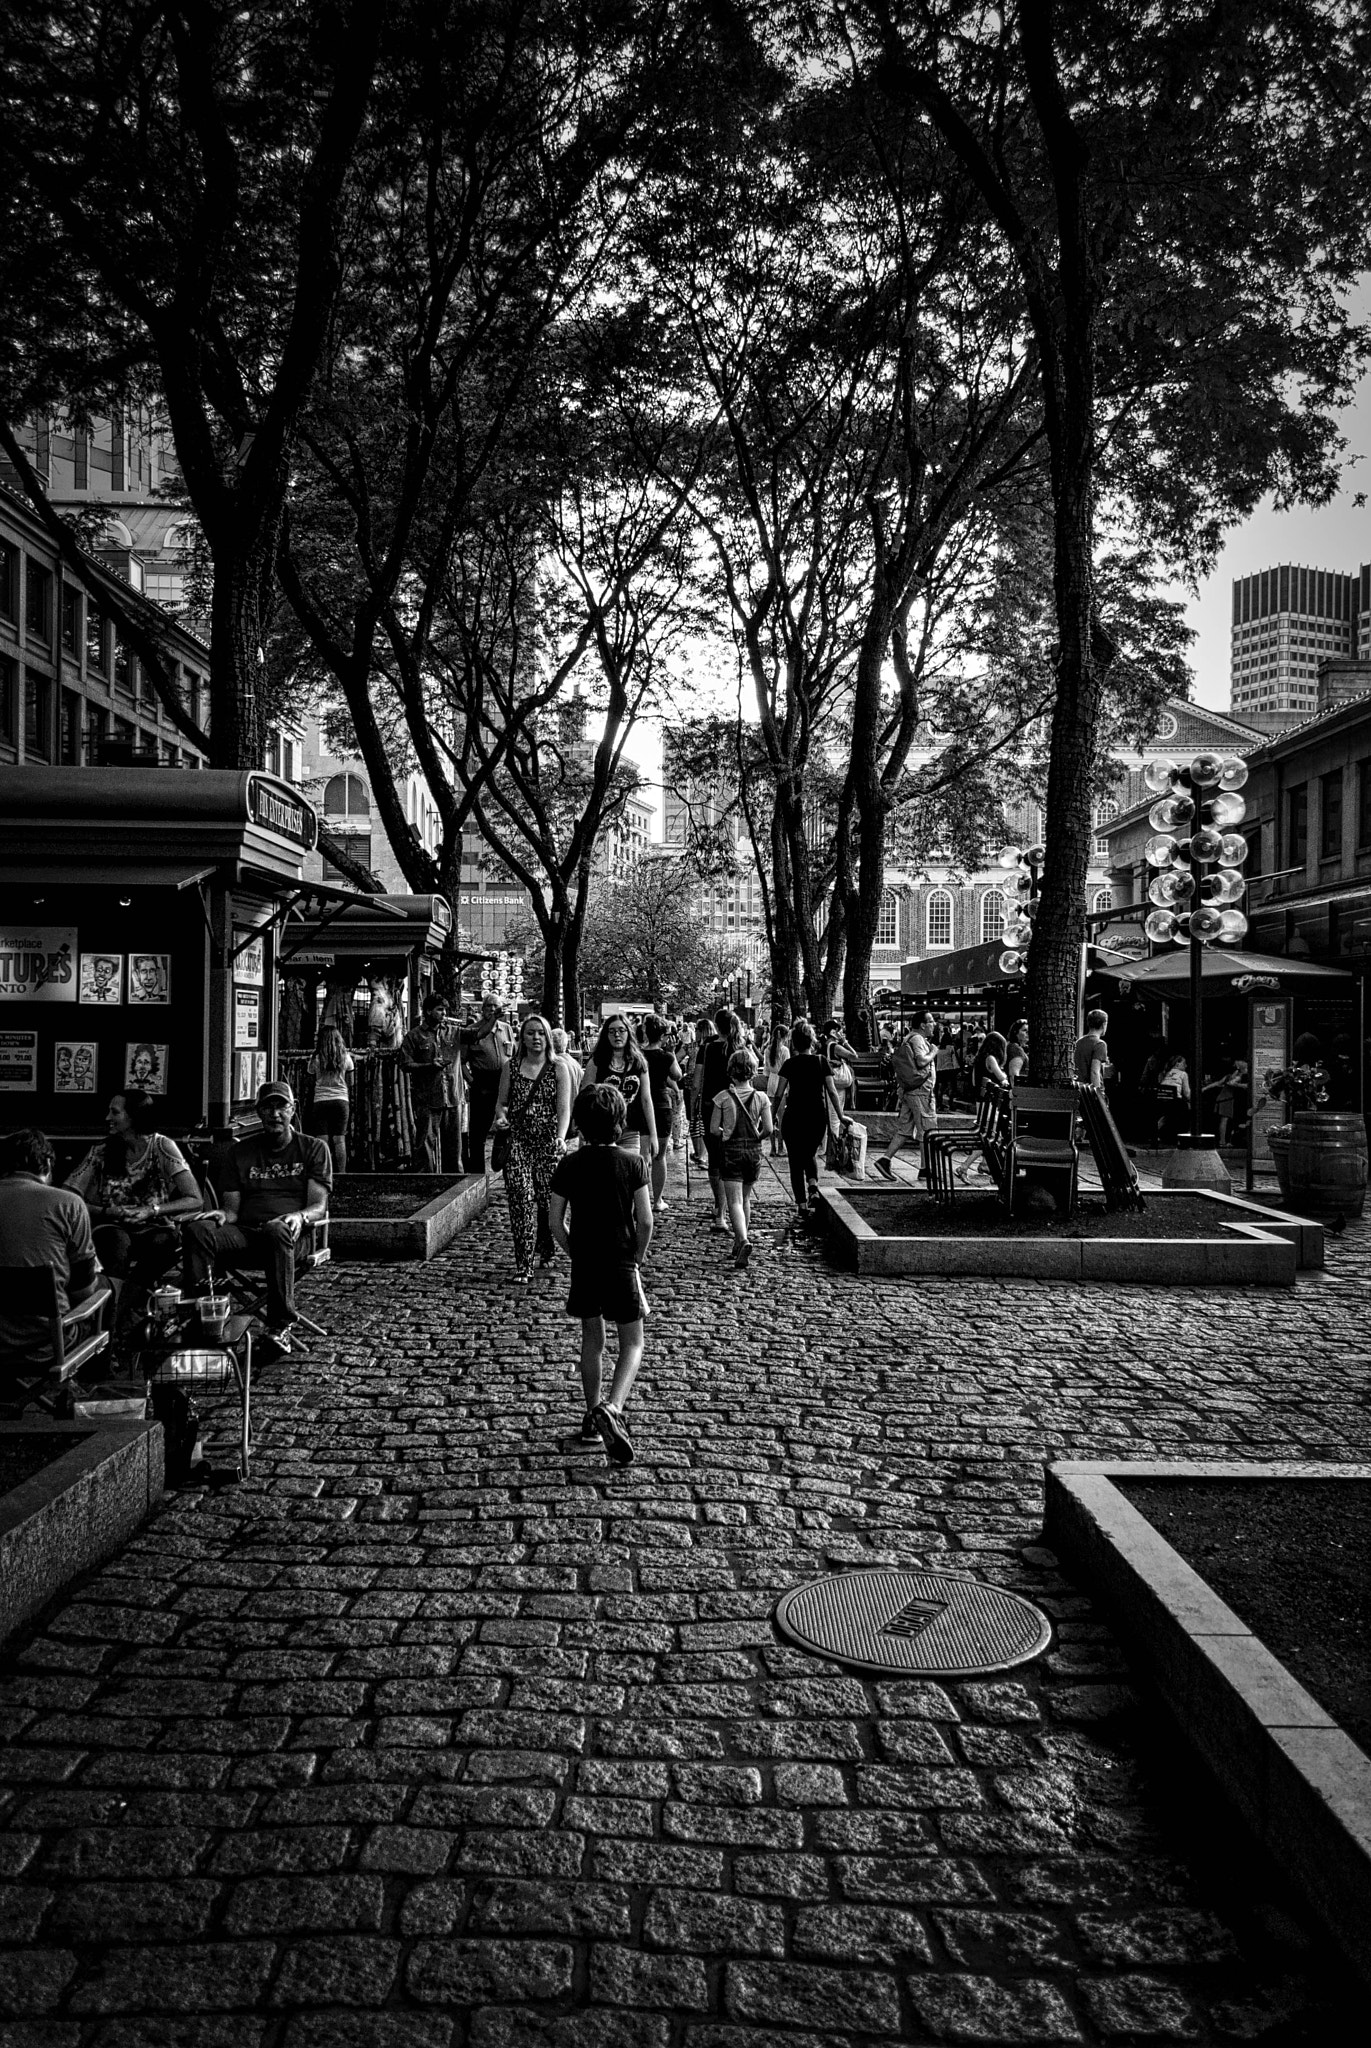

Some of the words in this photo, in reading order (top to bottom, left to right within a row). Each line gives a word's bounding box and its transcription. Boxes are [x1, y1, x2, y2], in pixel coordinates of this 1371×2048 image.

[471, 896, 503, 905] Citizens
[504, 896, 524, 905] Bank
[0, 938, 42, 950] rketplace
[1099, 934, 1147, 949] Cheers
[0, 952, 72, 984] TURES
[1230, 973, 1280, 992] Cheers
[882, 1604, 938, 1637] DRAIN
